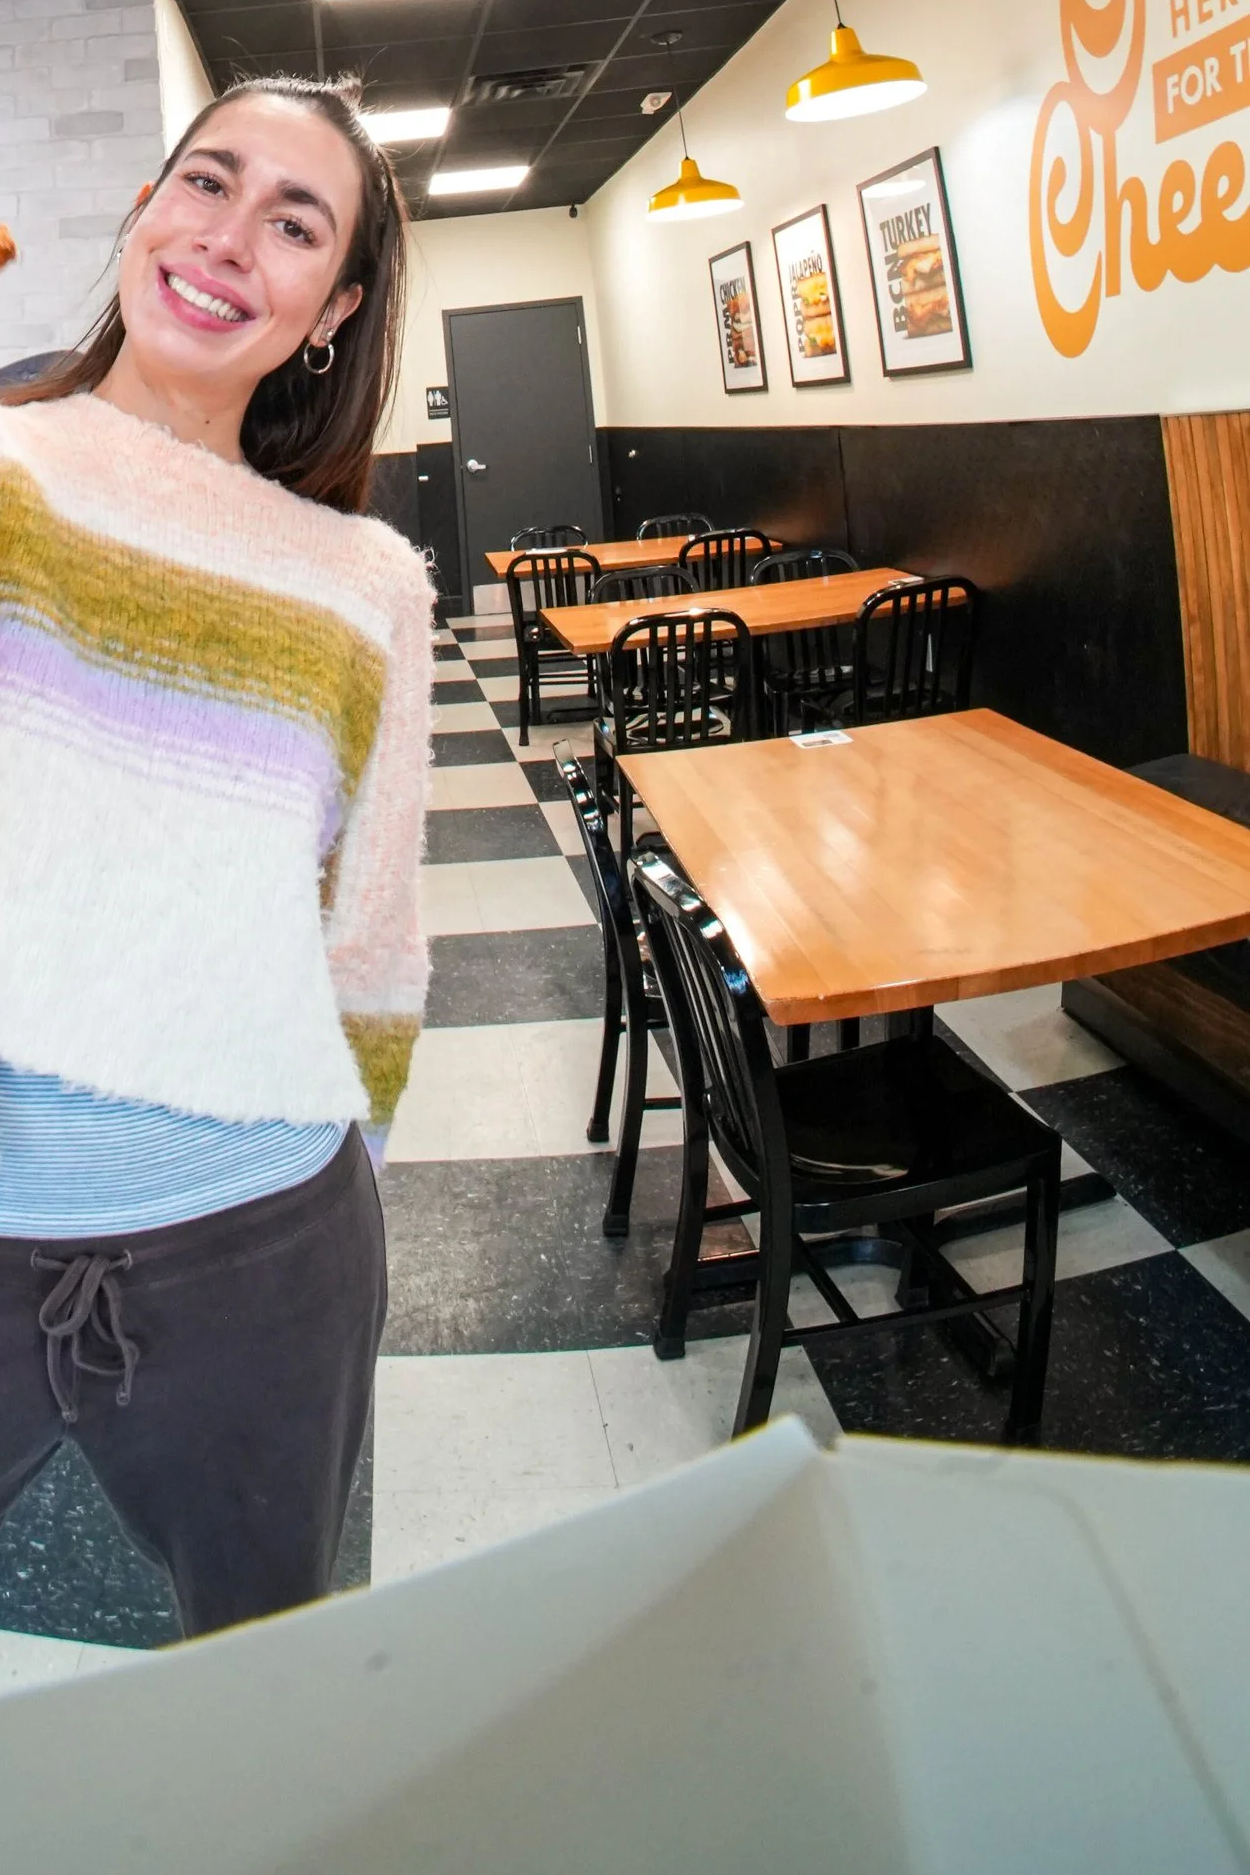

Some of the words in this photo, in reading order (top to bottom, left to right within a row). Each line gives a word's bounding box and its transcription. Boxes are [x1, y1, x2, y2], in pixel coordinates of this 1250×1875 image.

[1166, 56, 1223, 114] FOR
[879, 202, 932, 252] TURKEY
[720, 276, 746, 305] CHICKEN
[789, 249, 823, 285] JALAPEÑO
[884, 251, 910, 333] BCN
